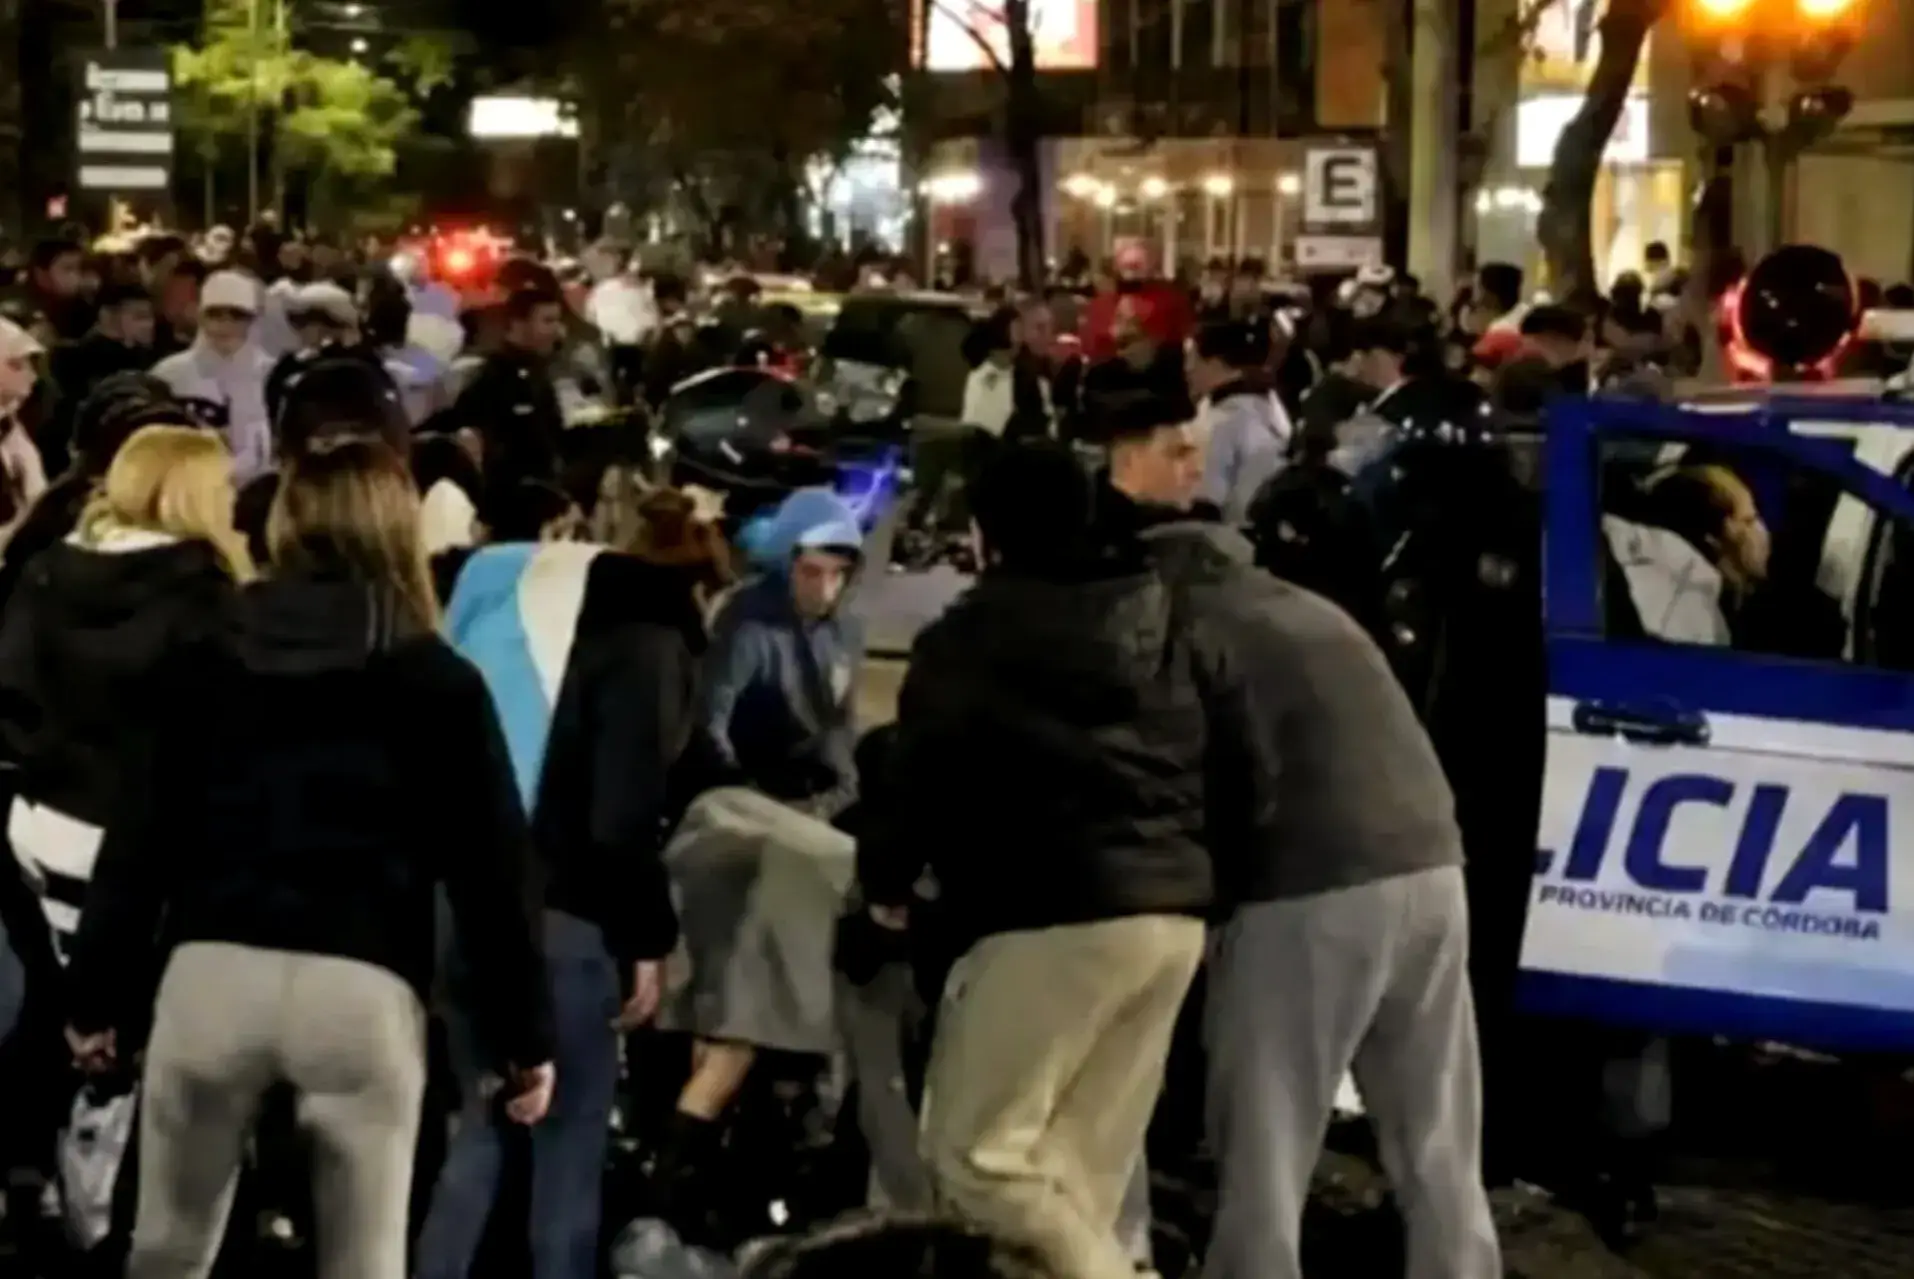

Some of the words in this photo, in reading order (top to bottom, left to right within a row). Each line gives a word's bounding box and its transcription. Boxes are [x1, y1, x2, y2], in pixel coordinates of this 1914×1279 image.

[1322, 156, 1362, 206] E
[1534, 766, 1889, 914] ICIA
[1538, 885, 1691, 919] PROVINCIA
[1698, 903, 1735, 925] DE
